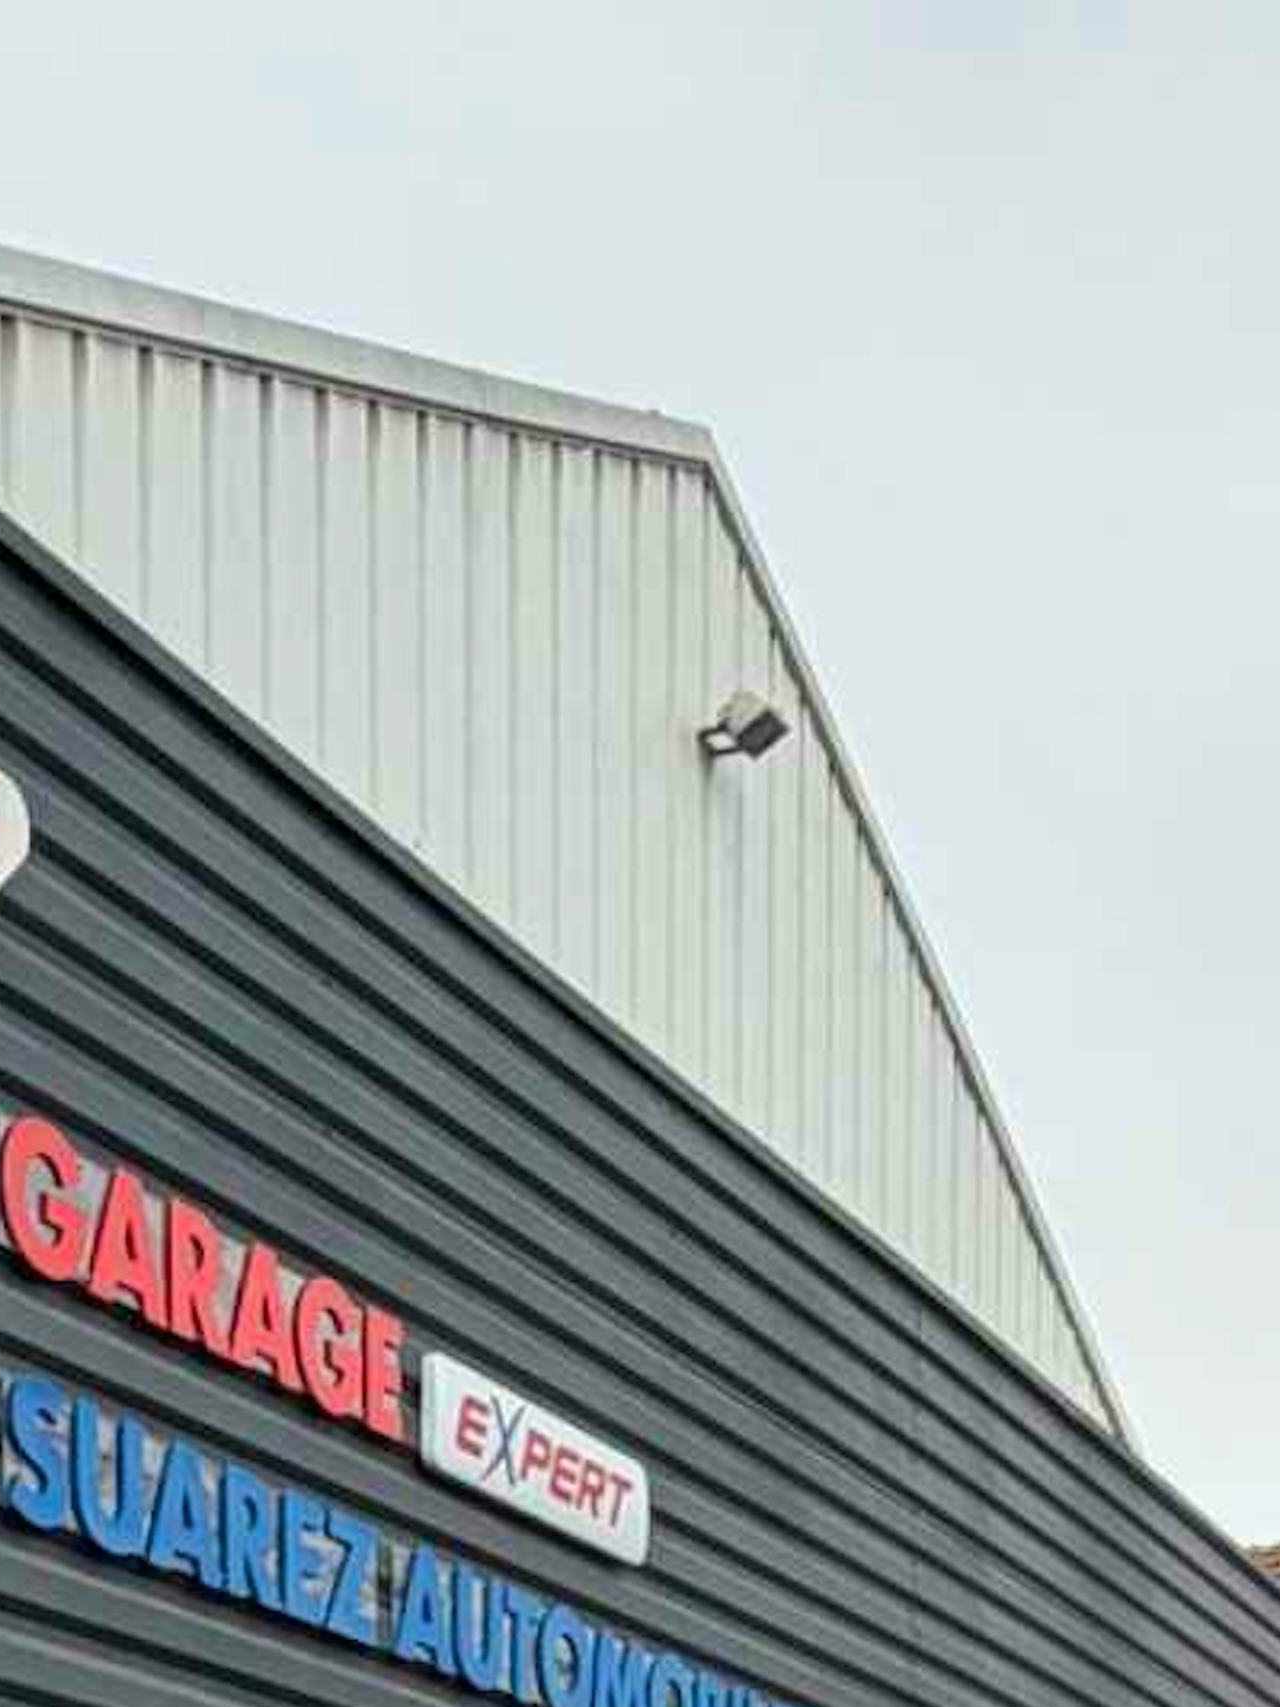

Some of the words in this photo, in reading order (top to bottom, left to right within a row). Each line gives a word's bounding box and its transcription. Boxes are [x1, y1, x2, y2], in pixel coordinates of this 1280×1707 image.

[0, 1115, 408, 1440] GARAGE
[3, 1373, 380, 1645] SUAREZ
[455, 1393, 632, 1527] EXPERT
